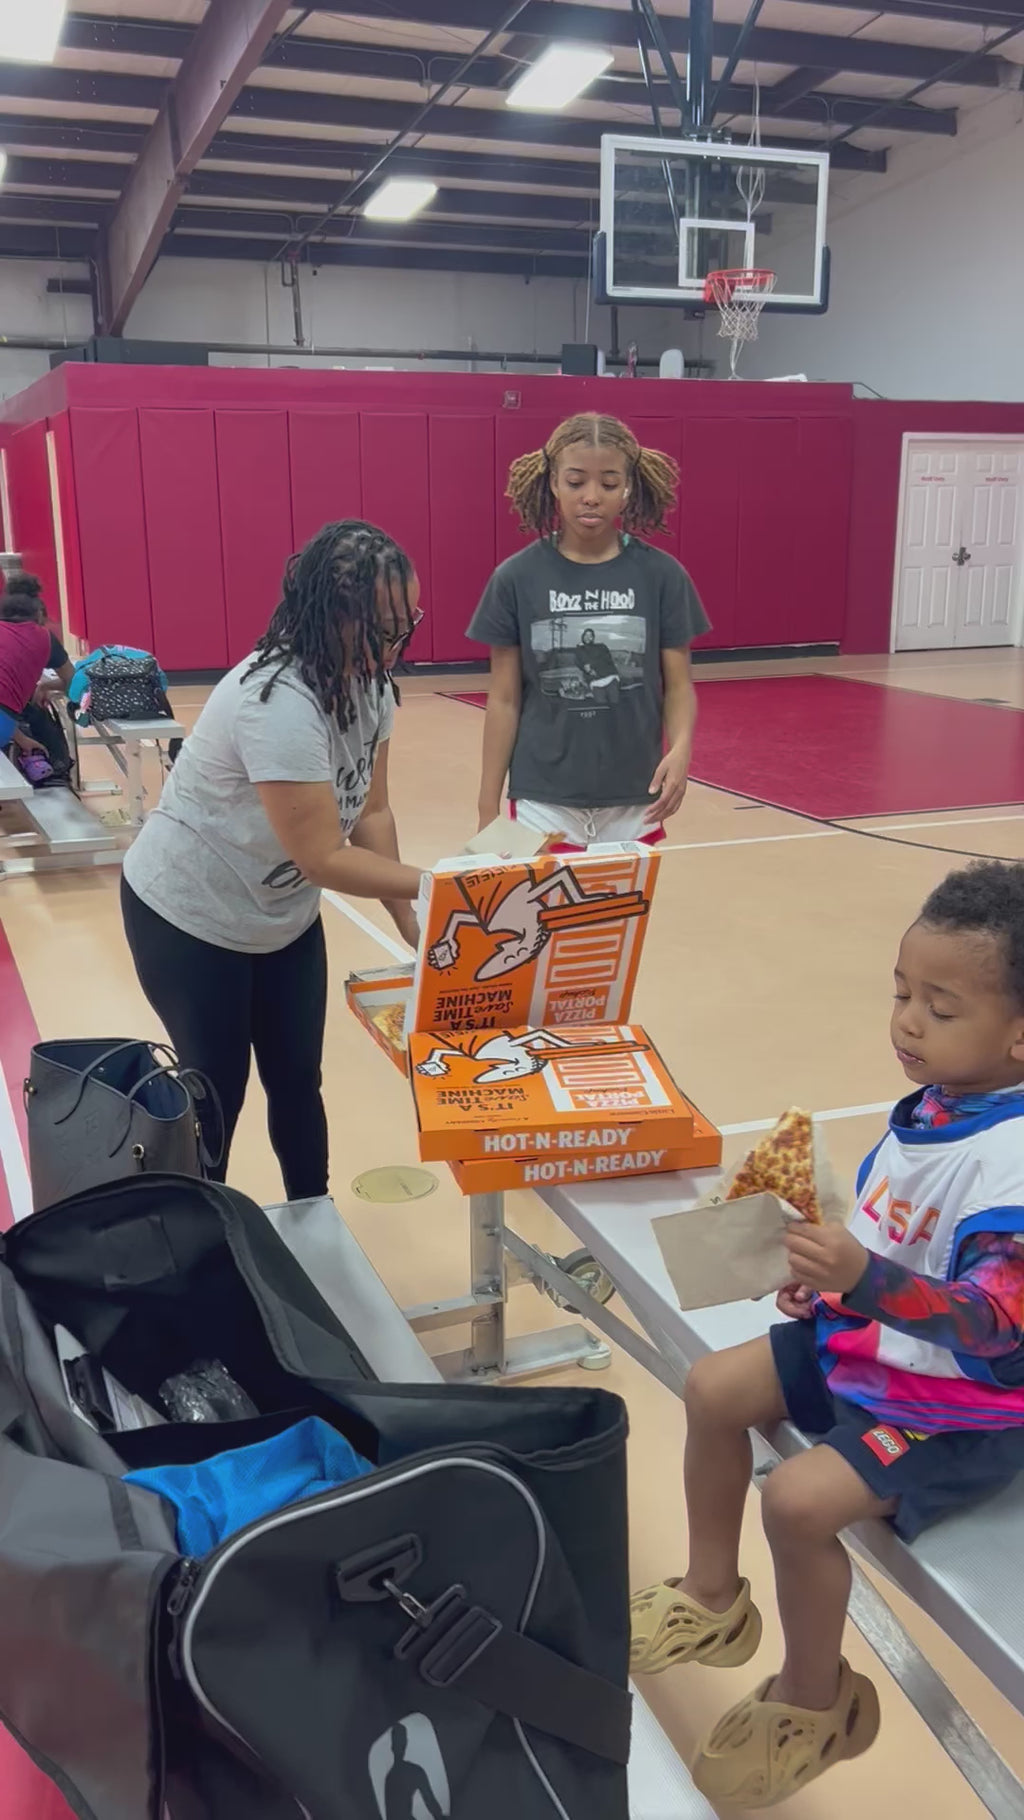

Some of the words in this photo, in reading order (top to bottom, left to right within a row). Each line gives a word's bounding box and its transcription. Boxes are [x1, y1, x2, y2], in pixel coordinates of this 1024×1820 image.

[549, 590, 582, 612] BOYZ
[584, 602, 599, 611] THE
[601, 588, 635, 610] HOOD
[436, 989, 513, 1009] MACHINE
[549, 995, 606, 1011] PORTAL
[433, 1007, 474, 1022] TIME
[474, 1001, 514, 1014] Save
[465, 1016, 496, 1030] IT'S
[554, 1008, 596, 1023] PIZZA
[450, 1020, 462, 1031] A
[436, 1088, 524, 1098] MACHINE
[436, 1097, 484, 1105] TIME
[477, 1103, 514, 1112] IT'S
[484, 1127, 632, 1152] HOT-N-READY
[524, 1150, 665, 1182] HOT-N-READY
[871, 1428, 900, 1455] LEGO
